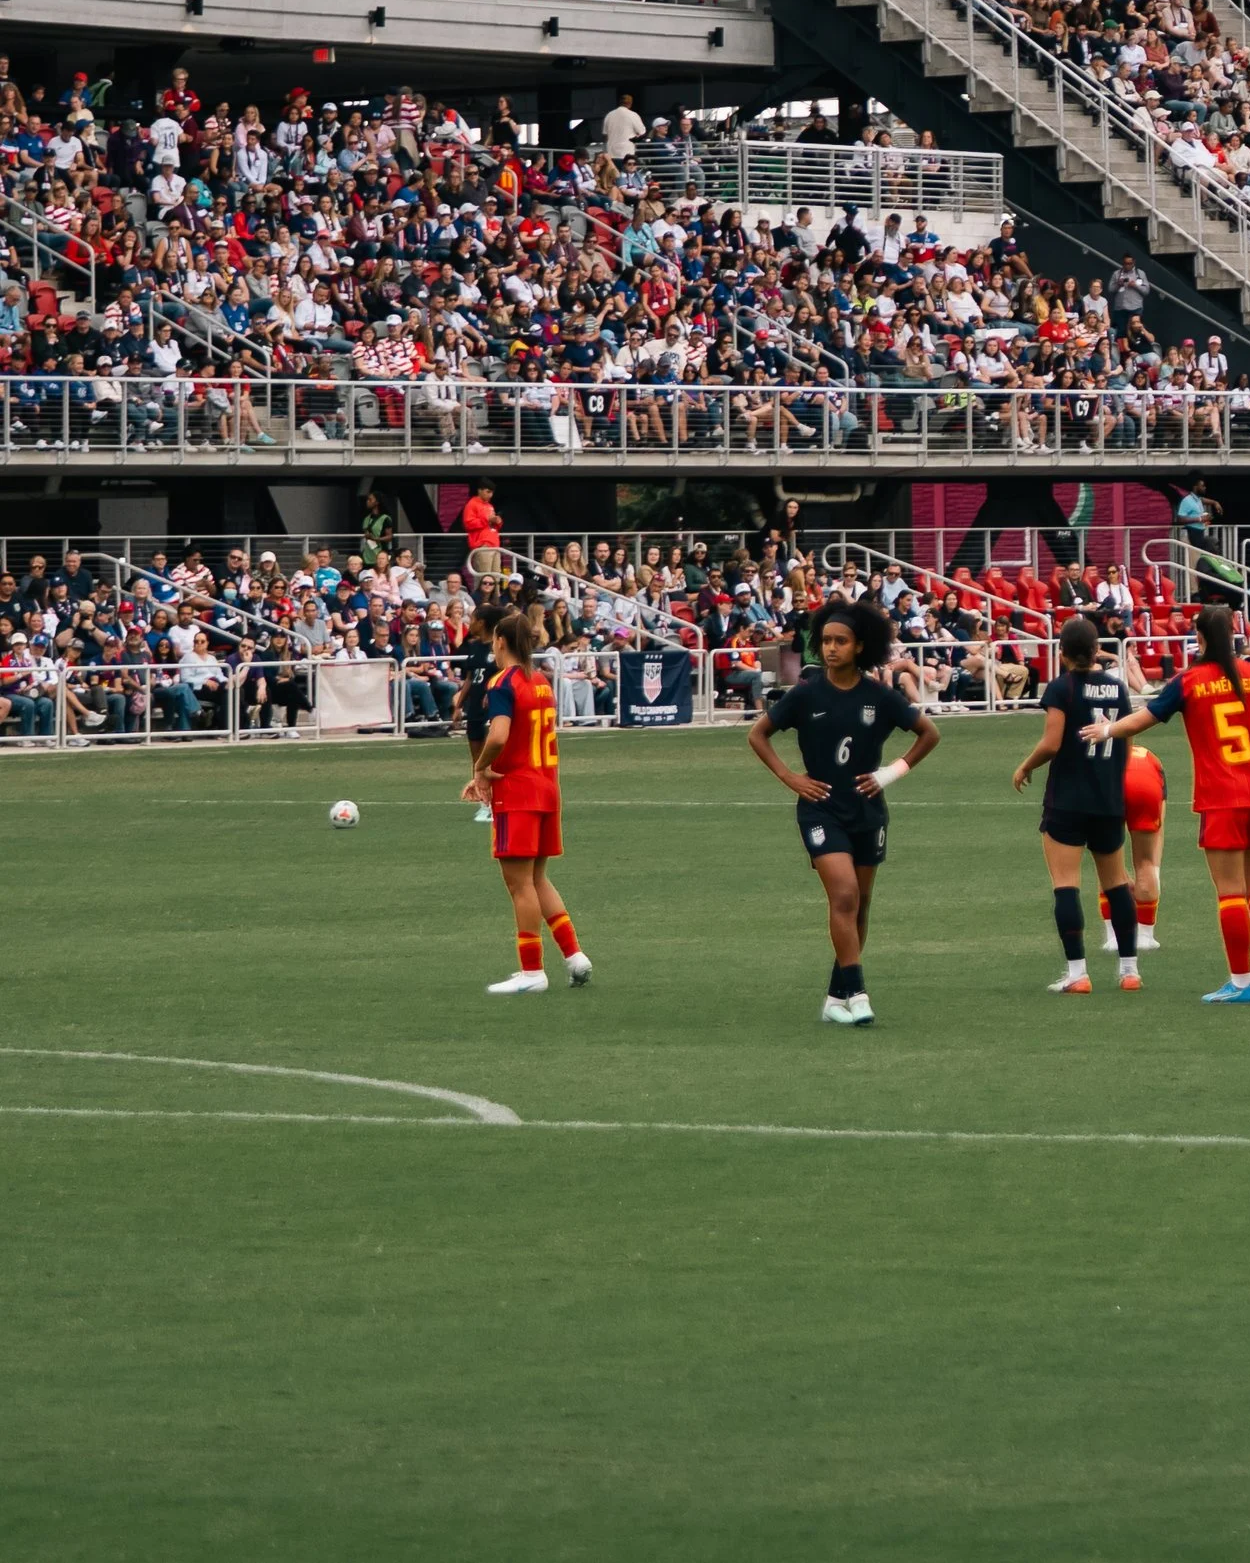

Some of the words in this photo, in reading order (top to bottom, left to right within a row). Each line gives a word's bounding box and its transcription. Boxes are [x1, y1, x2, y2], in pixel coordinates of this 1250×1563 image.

[163, 132, 176, 149] 10
[588, 395, 605, 413] C8
[1076, 400, 1090, 416] C9
[473, 668, 485, 684] 25
[1084, 683, 1119, 698] WILSON
[1195, 682, 1210, 697] M.
[531, 707, 558, 767] 12
[1088, 707, 1119, 757] 11
[838, 736, 852, 764] 6
[878, 825, 885, 848] 6
